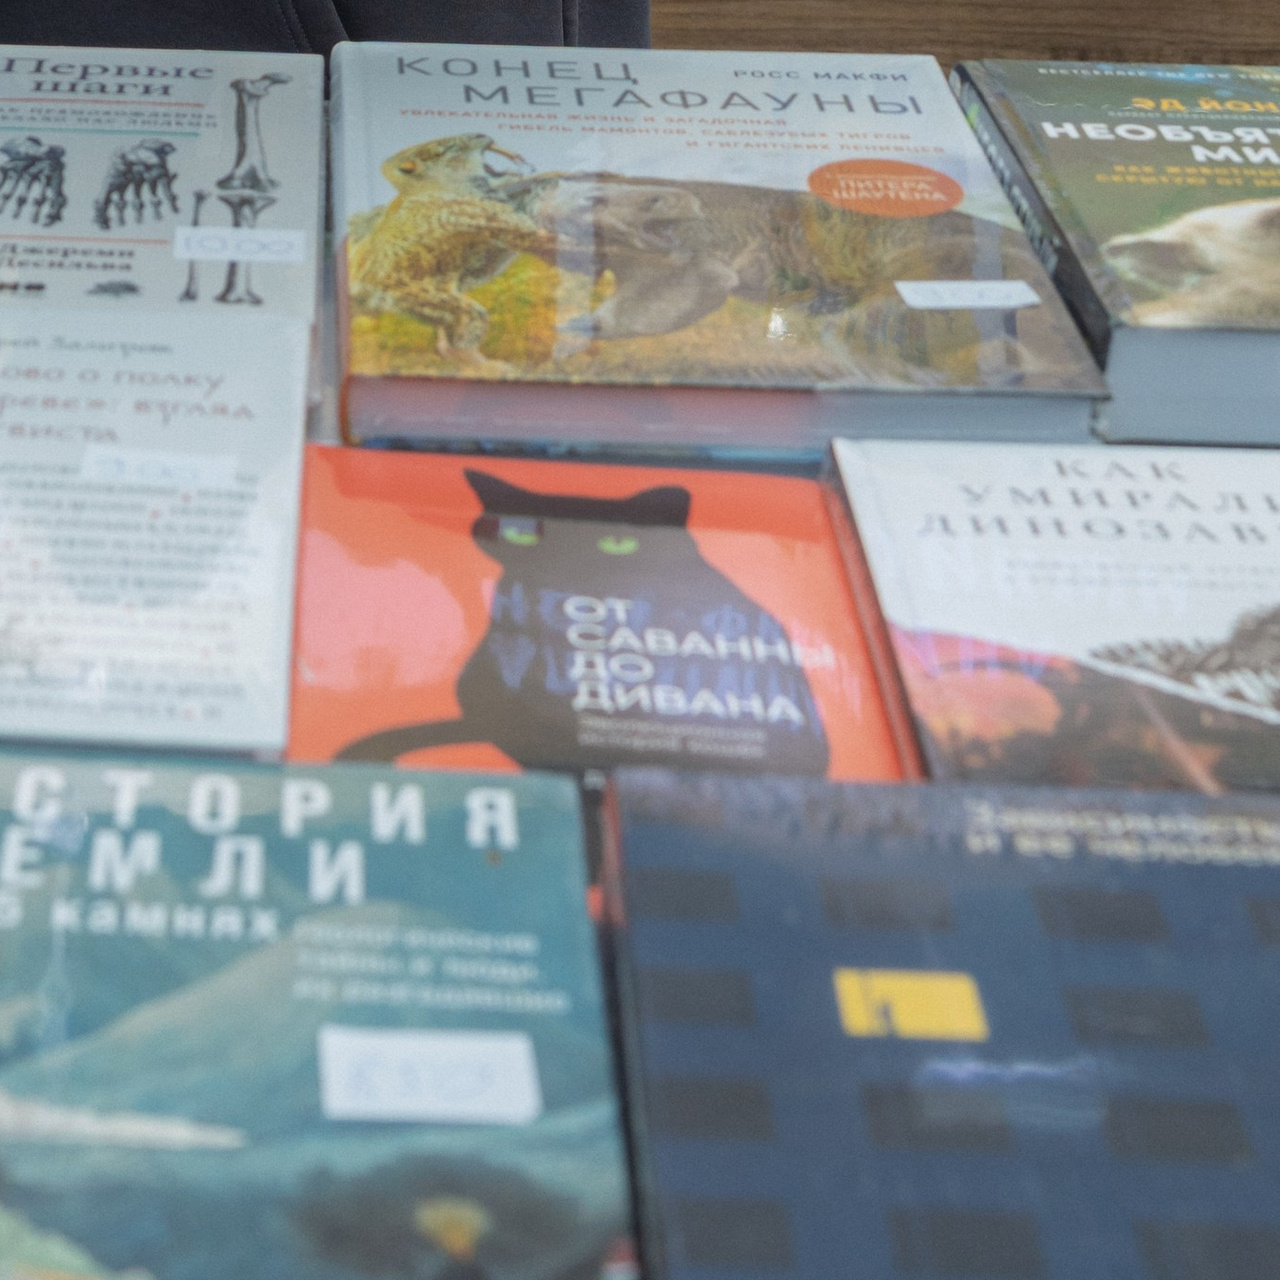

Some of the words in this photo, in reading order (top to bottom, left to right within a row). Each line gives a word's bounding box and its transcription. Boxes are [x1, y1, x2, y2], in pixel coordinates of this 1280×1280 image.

[0, 57, 214, 80] Первые
[396, 56, 639, 85] КОНЕЦ
[733, 69, 800, 81] РОСС
[813, 71, 908, 83] МАКФИ
[33, 80, 173, 96] шаги
[463, 83, 924, 115] МЕГАФАУНЫ
[400, 108, 561, 121] УВЛЕКАТЕЛЬНАЯ
[831, 188, 948, 202] ШАУТЕНА
[838, 177, 933, 190] ПИТЕРА
[1055, 459, 1188, 480] КАК
[563, 596, 633, 623] ОТ
[567, 625, 836, 669] САВАННЫ
[570, 652, 654, 683] ДО
[572, 680, 804, 724] ДИВАНА
